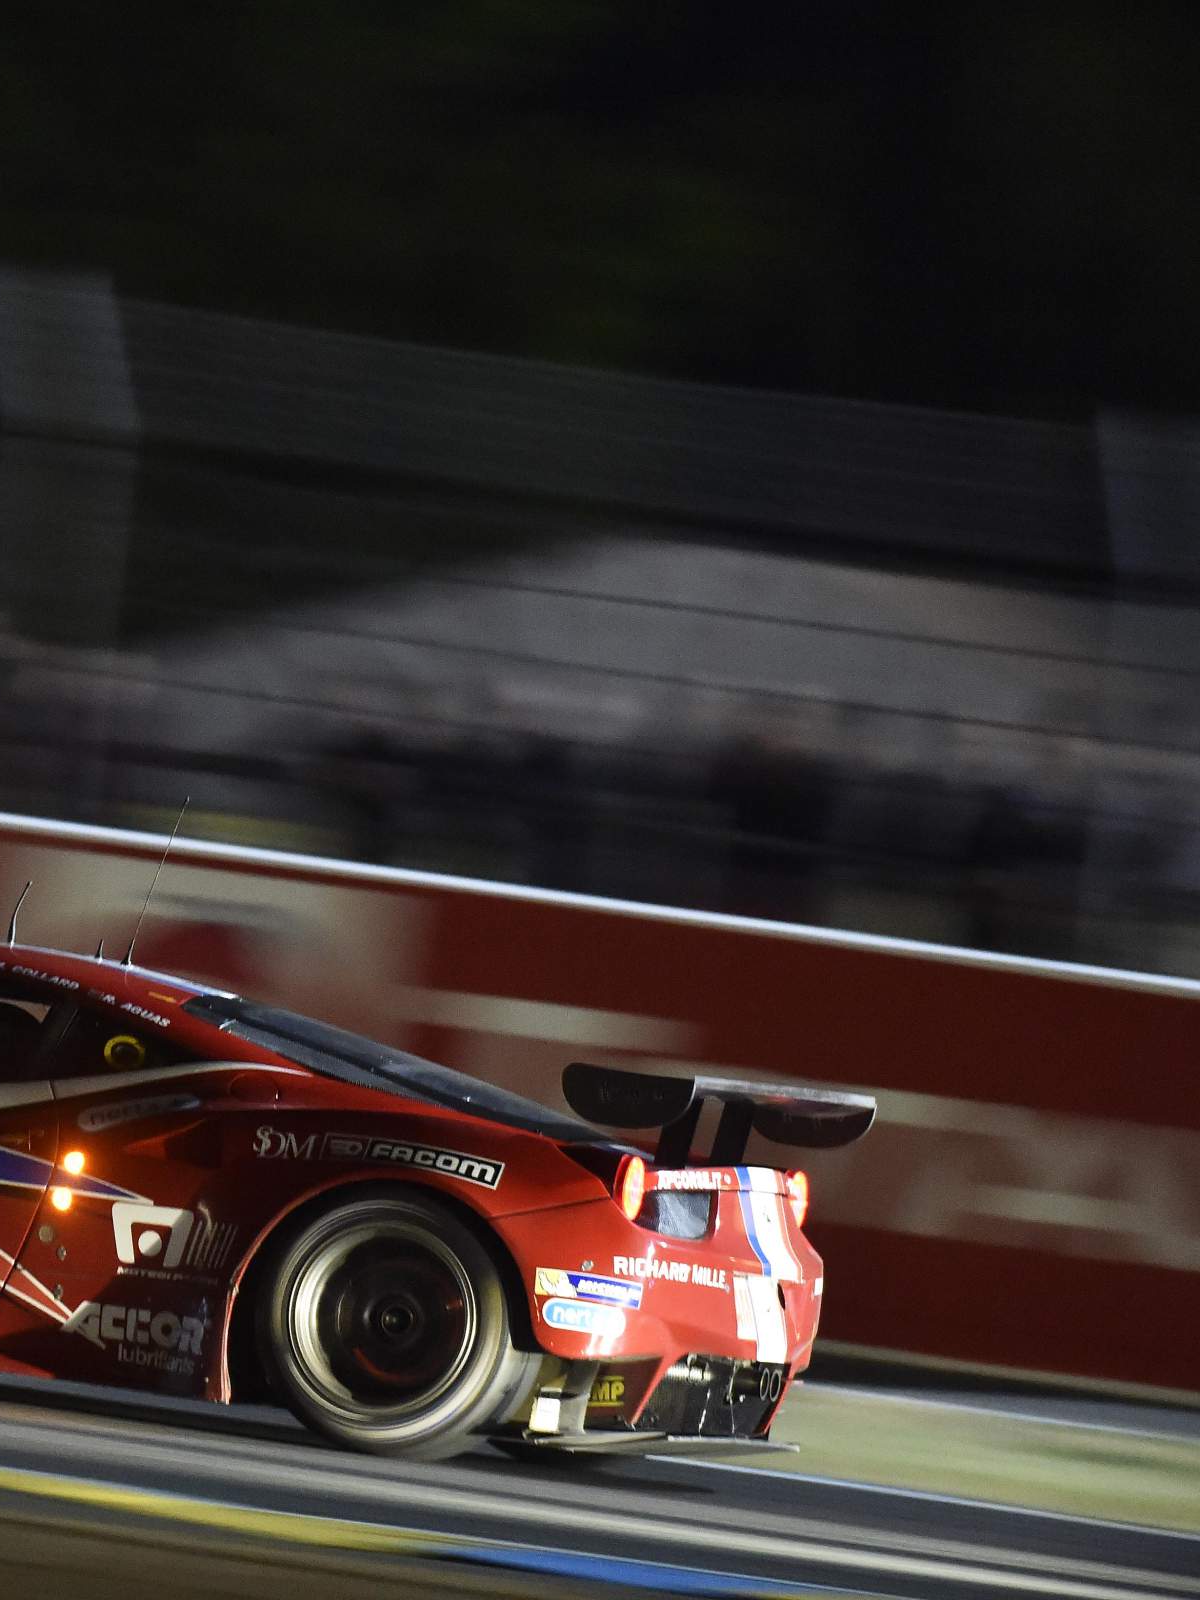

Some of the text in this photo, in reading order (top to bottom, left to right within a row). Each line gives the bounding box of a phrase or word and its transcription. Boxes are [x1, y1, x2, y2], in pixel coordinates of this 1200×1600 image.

[12, 964, 81, 991] COLLARD
[119, 1002, 172, 1028] AGUAS
[370, 1143, 497, 1184] FACOM
[613, 1256, 726, 1288] RICHARD MILLE
[589, 1381, 625, 1402] MP
